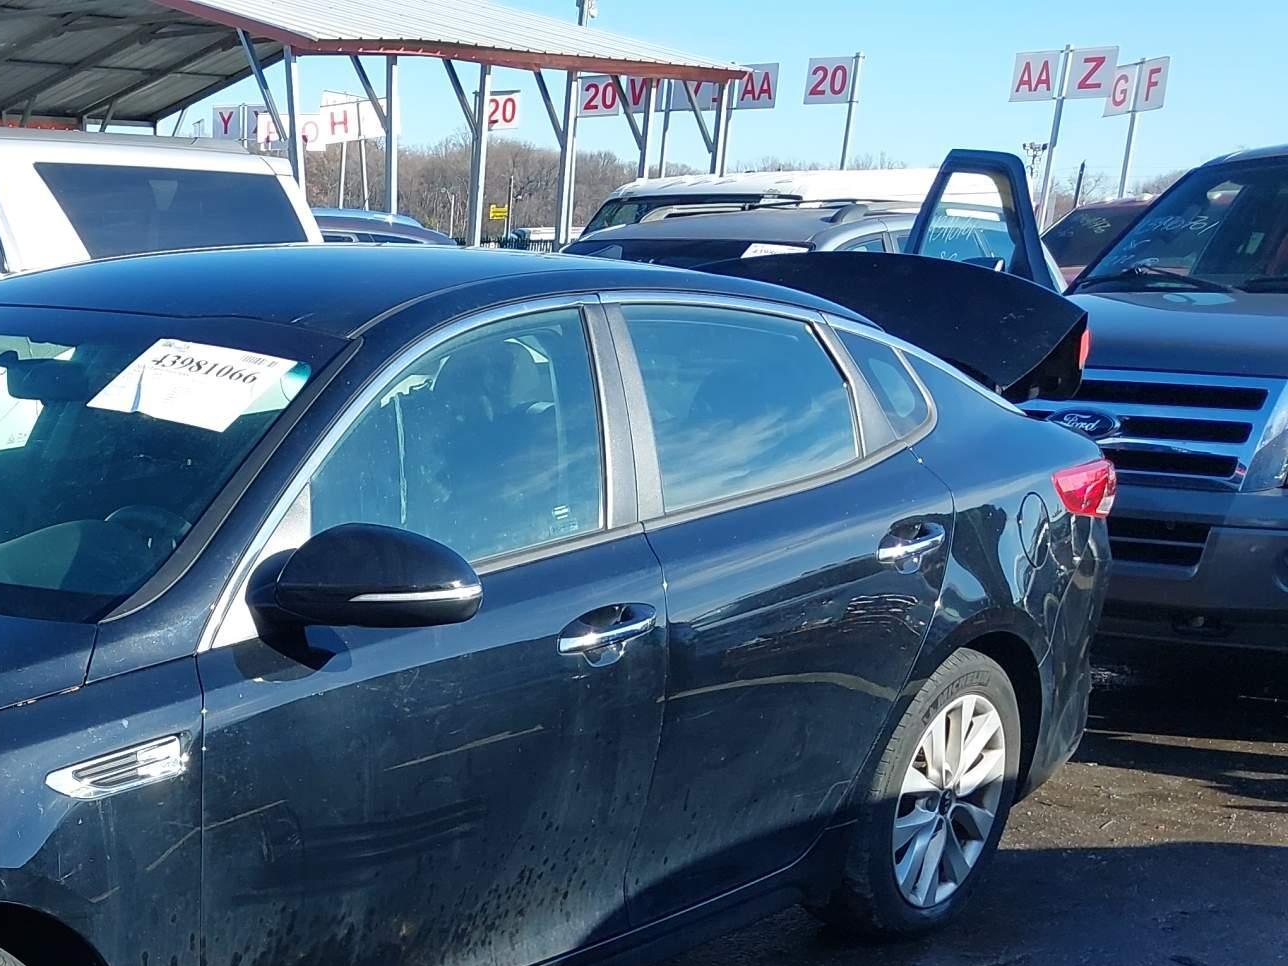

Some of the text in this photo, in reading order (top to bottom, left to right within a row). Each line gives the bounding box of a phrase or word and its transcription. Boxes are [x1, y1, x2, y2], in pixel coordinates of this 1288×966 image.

[740, 71, 773, 101] AA
[808, 64, 848, 96] 20
[1016, 60, 1051, 93] AA
[1077, 56, 1107, 90] Z
[1144, 66, 1162, 102] F
[583, 82, 617, 111] 20
[1112, 74, 1129, 107] G
[219, 111, 234, 135] Y
[330, 110, 349, 136] H
[488, 97, 516, 124] 20
[151, 353, 259, 384] 43981066
[1064, 413, 1101, 432] Ford
